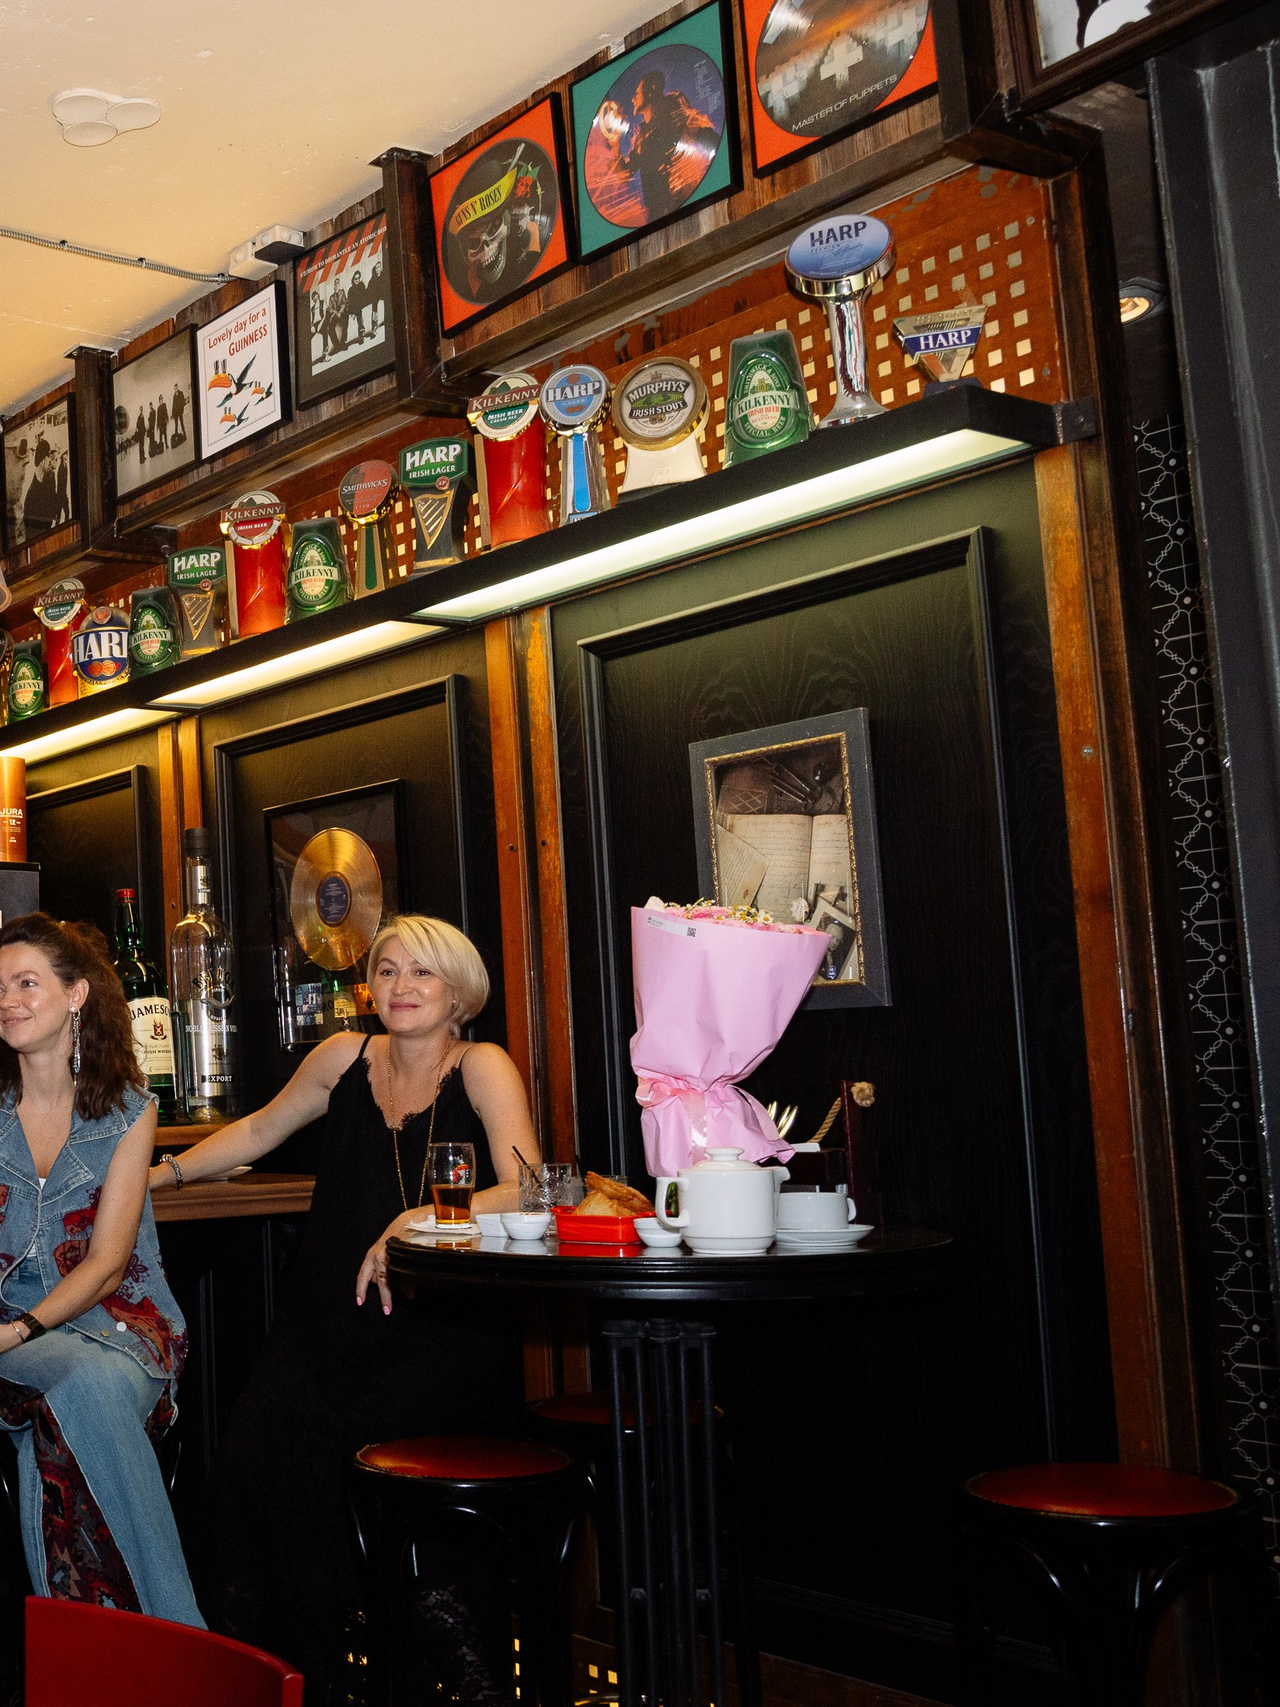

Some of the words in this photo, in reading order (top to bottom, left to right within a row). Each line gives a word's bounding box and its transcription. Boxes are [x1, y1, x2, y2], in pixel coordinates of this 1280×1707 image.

[792, 107, 833, 132] MASTER
[834, 100, 848, 110] OF
[850, 74, 898, 104] PUPPETS
[454, 205, 472, 227] GUNS
[480, 186, 502, 212] ROSES
[810, 220, 867, 248] HARP
[208, 326, 232, 350] Lovely
[234, 319, 248, 334] day
[248, 310, 260, 326] for
[261, 308, 267, 316] a
[228, 324, 268, 356] GUINNESS
[920, 330, 972, 350] HARP
[472, 388, 540, 411] KILKENNY
[548, 382, 600, 402] HARP
[488, 412, 506, 420] IRISH
[507, 408, 524, 416] BEER
[632, 407, 655, 417] IRISH
[656, 400, 683, 414] STOUT
[738, 394, 792, 414] KILKENNY
[748, 408, 764, 417] IRISH
[764, 406, 780, 414] BEER
[744, 422, 771, 437] SPECIAL
[773, 416, 786, 433] BEER
[406, 444, 461, 470] HARP
[409, 468, 430, 478] IRISH
[431, 465, 456, 475] LAGER
[224, 506, 282, 521] KILKENNY
[174, 552, 220, 573] HARP
[294, 568, 334, 580] KILKENNY
[38, 592, 82, 606] KILKENNY
[133, 631, 168, 646] KILKENNY
[0, 808, 24, 816] JURA
[130, 1004, 170, 1020] JAMES
